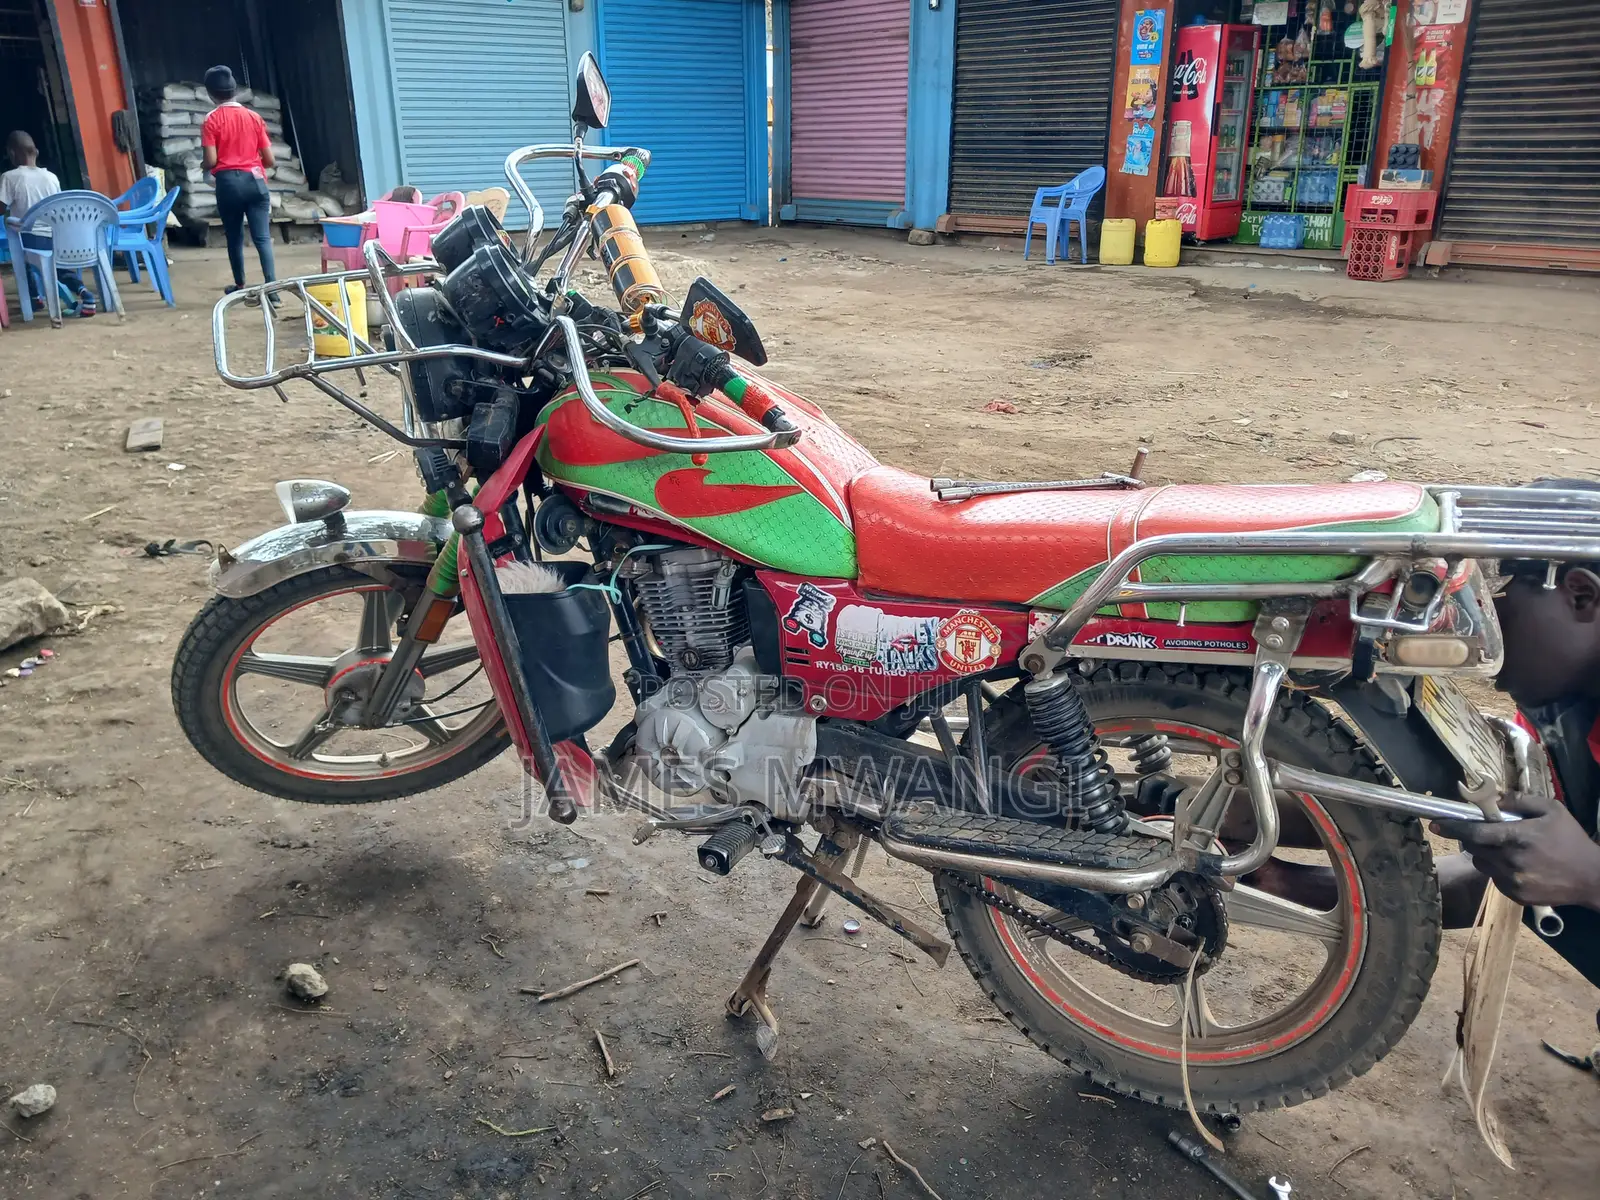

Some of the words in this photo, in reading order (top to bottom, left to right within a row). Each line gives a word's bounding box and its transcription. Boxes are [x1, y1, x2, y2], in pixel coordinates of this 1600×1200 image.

[943, 616, 995, 641] MANCHESTER
[1106, 633, 1154, 648] DRUNK
[1165, 639, 1203, 647] AVOIDING
[1204, 641, 1247, 649] POTHOLES
[869, 666, 907, 677] TURBO
[950, 660, 986, 672] UNITED
